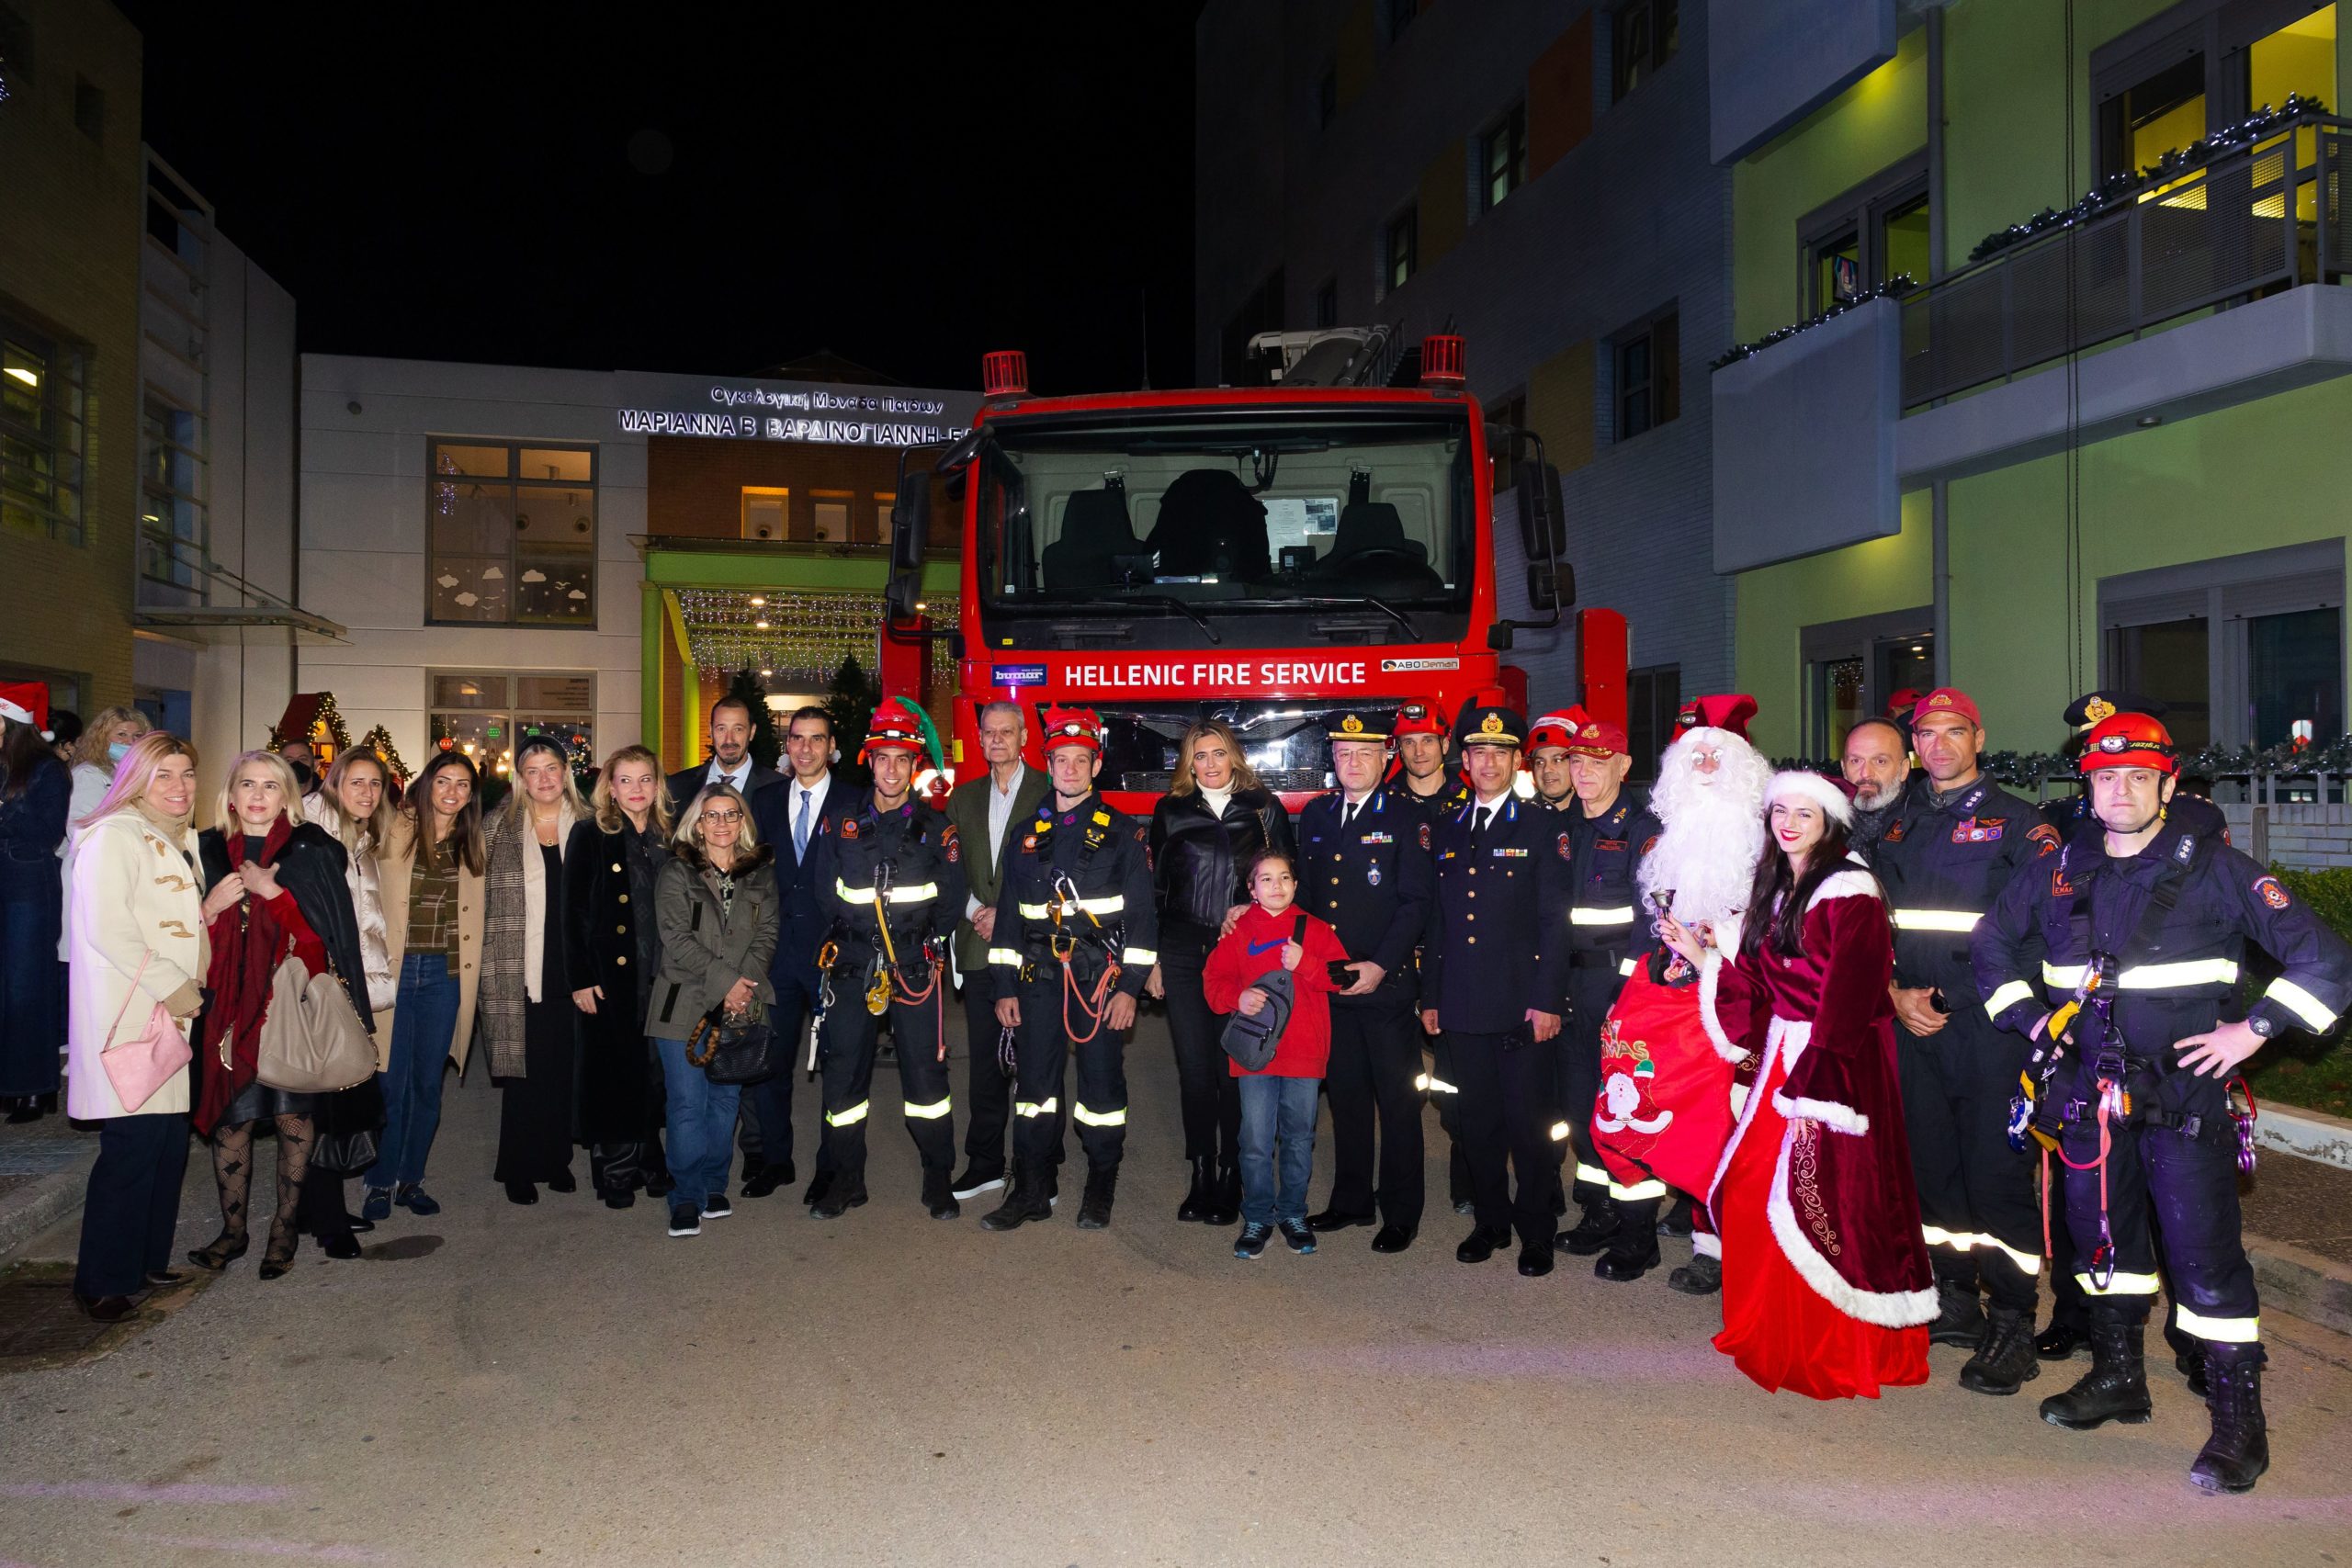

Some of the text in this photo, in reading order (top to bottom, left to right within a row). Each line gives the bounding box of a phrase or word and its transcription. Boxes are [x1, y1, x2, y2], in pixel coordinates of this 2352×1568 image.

[619, 410, 736, 436] ΜΑΡΙΑΝΝΑ
[995, 671, 1044, 680] bumar
[1066, 662, 1365, 686] HELLENIC FIRE SERVICE
